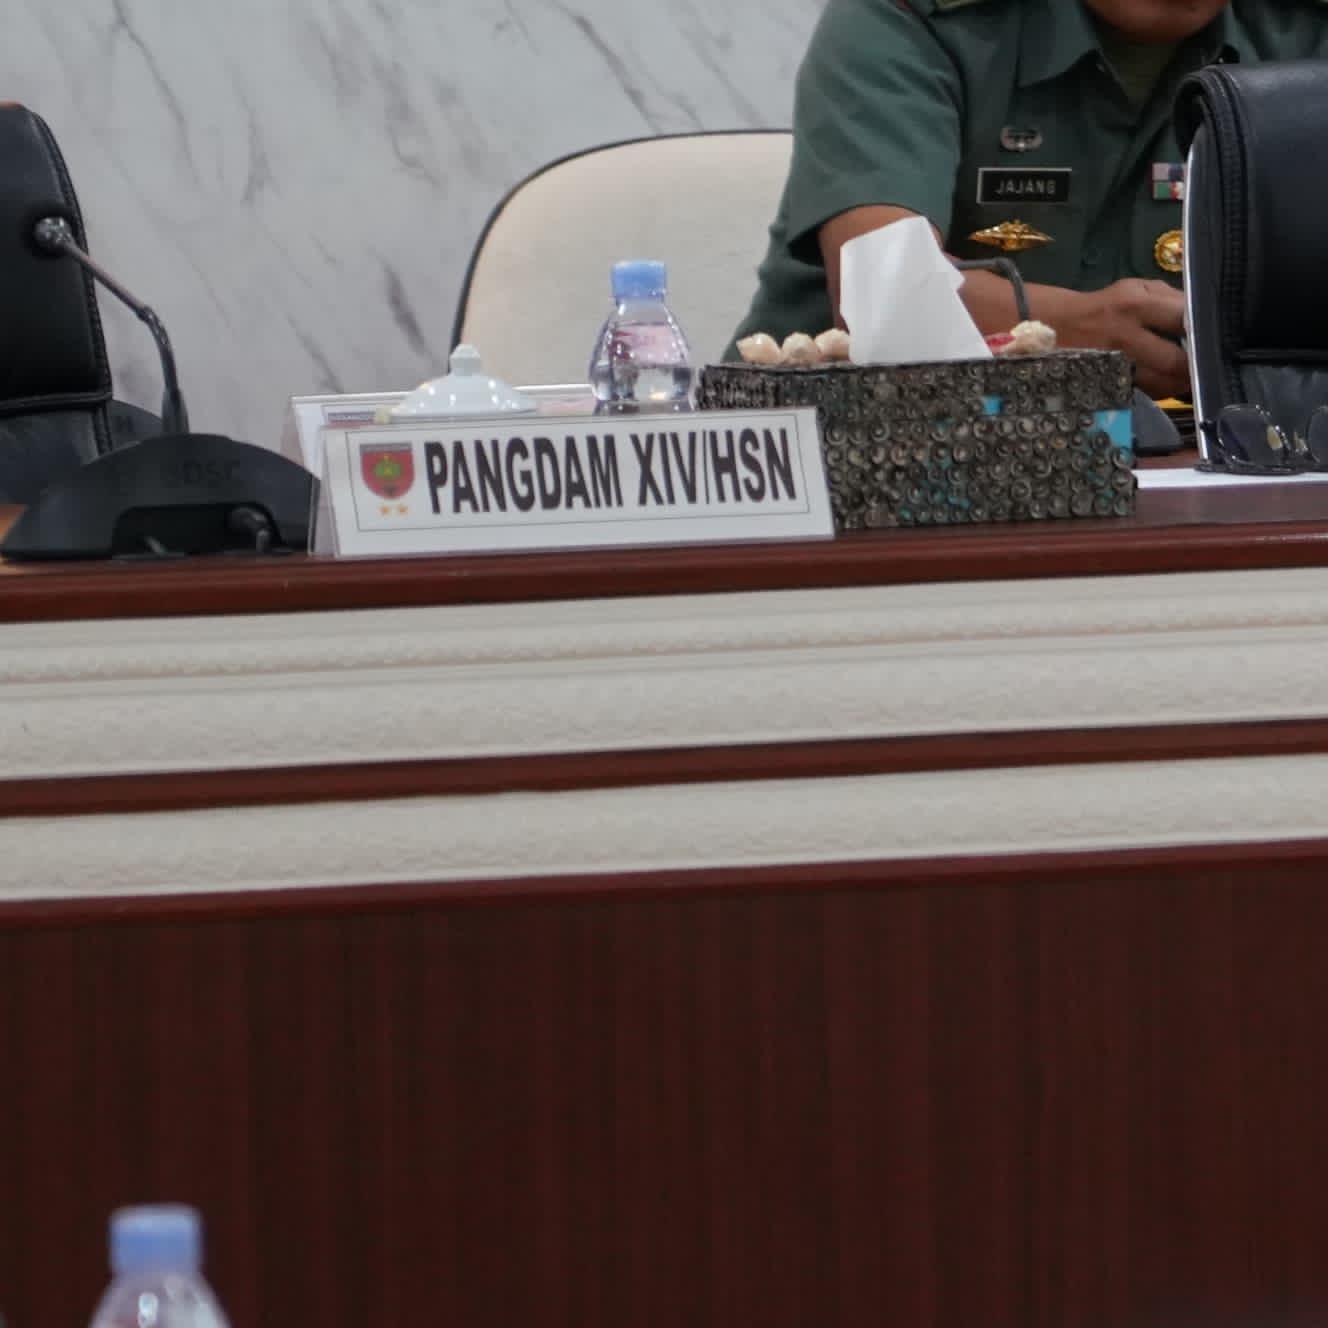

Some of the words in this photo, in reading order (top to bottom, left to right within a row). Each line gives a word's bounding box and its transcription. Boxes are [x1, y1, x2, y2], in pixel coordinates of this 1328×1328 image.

[993, 178, 1057, 194] JAJANG
[423, 433, 624, 514] PANGDAM
[630, 427, 797, 507] XIV/HSN
